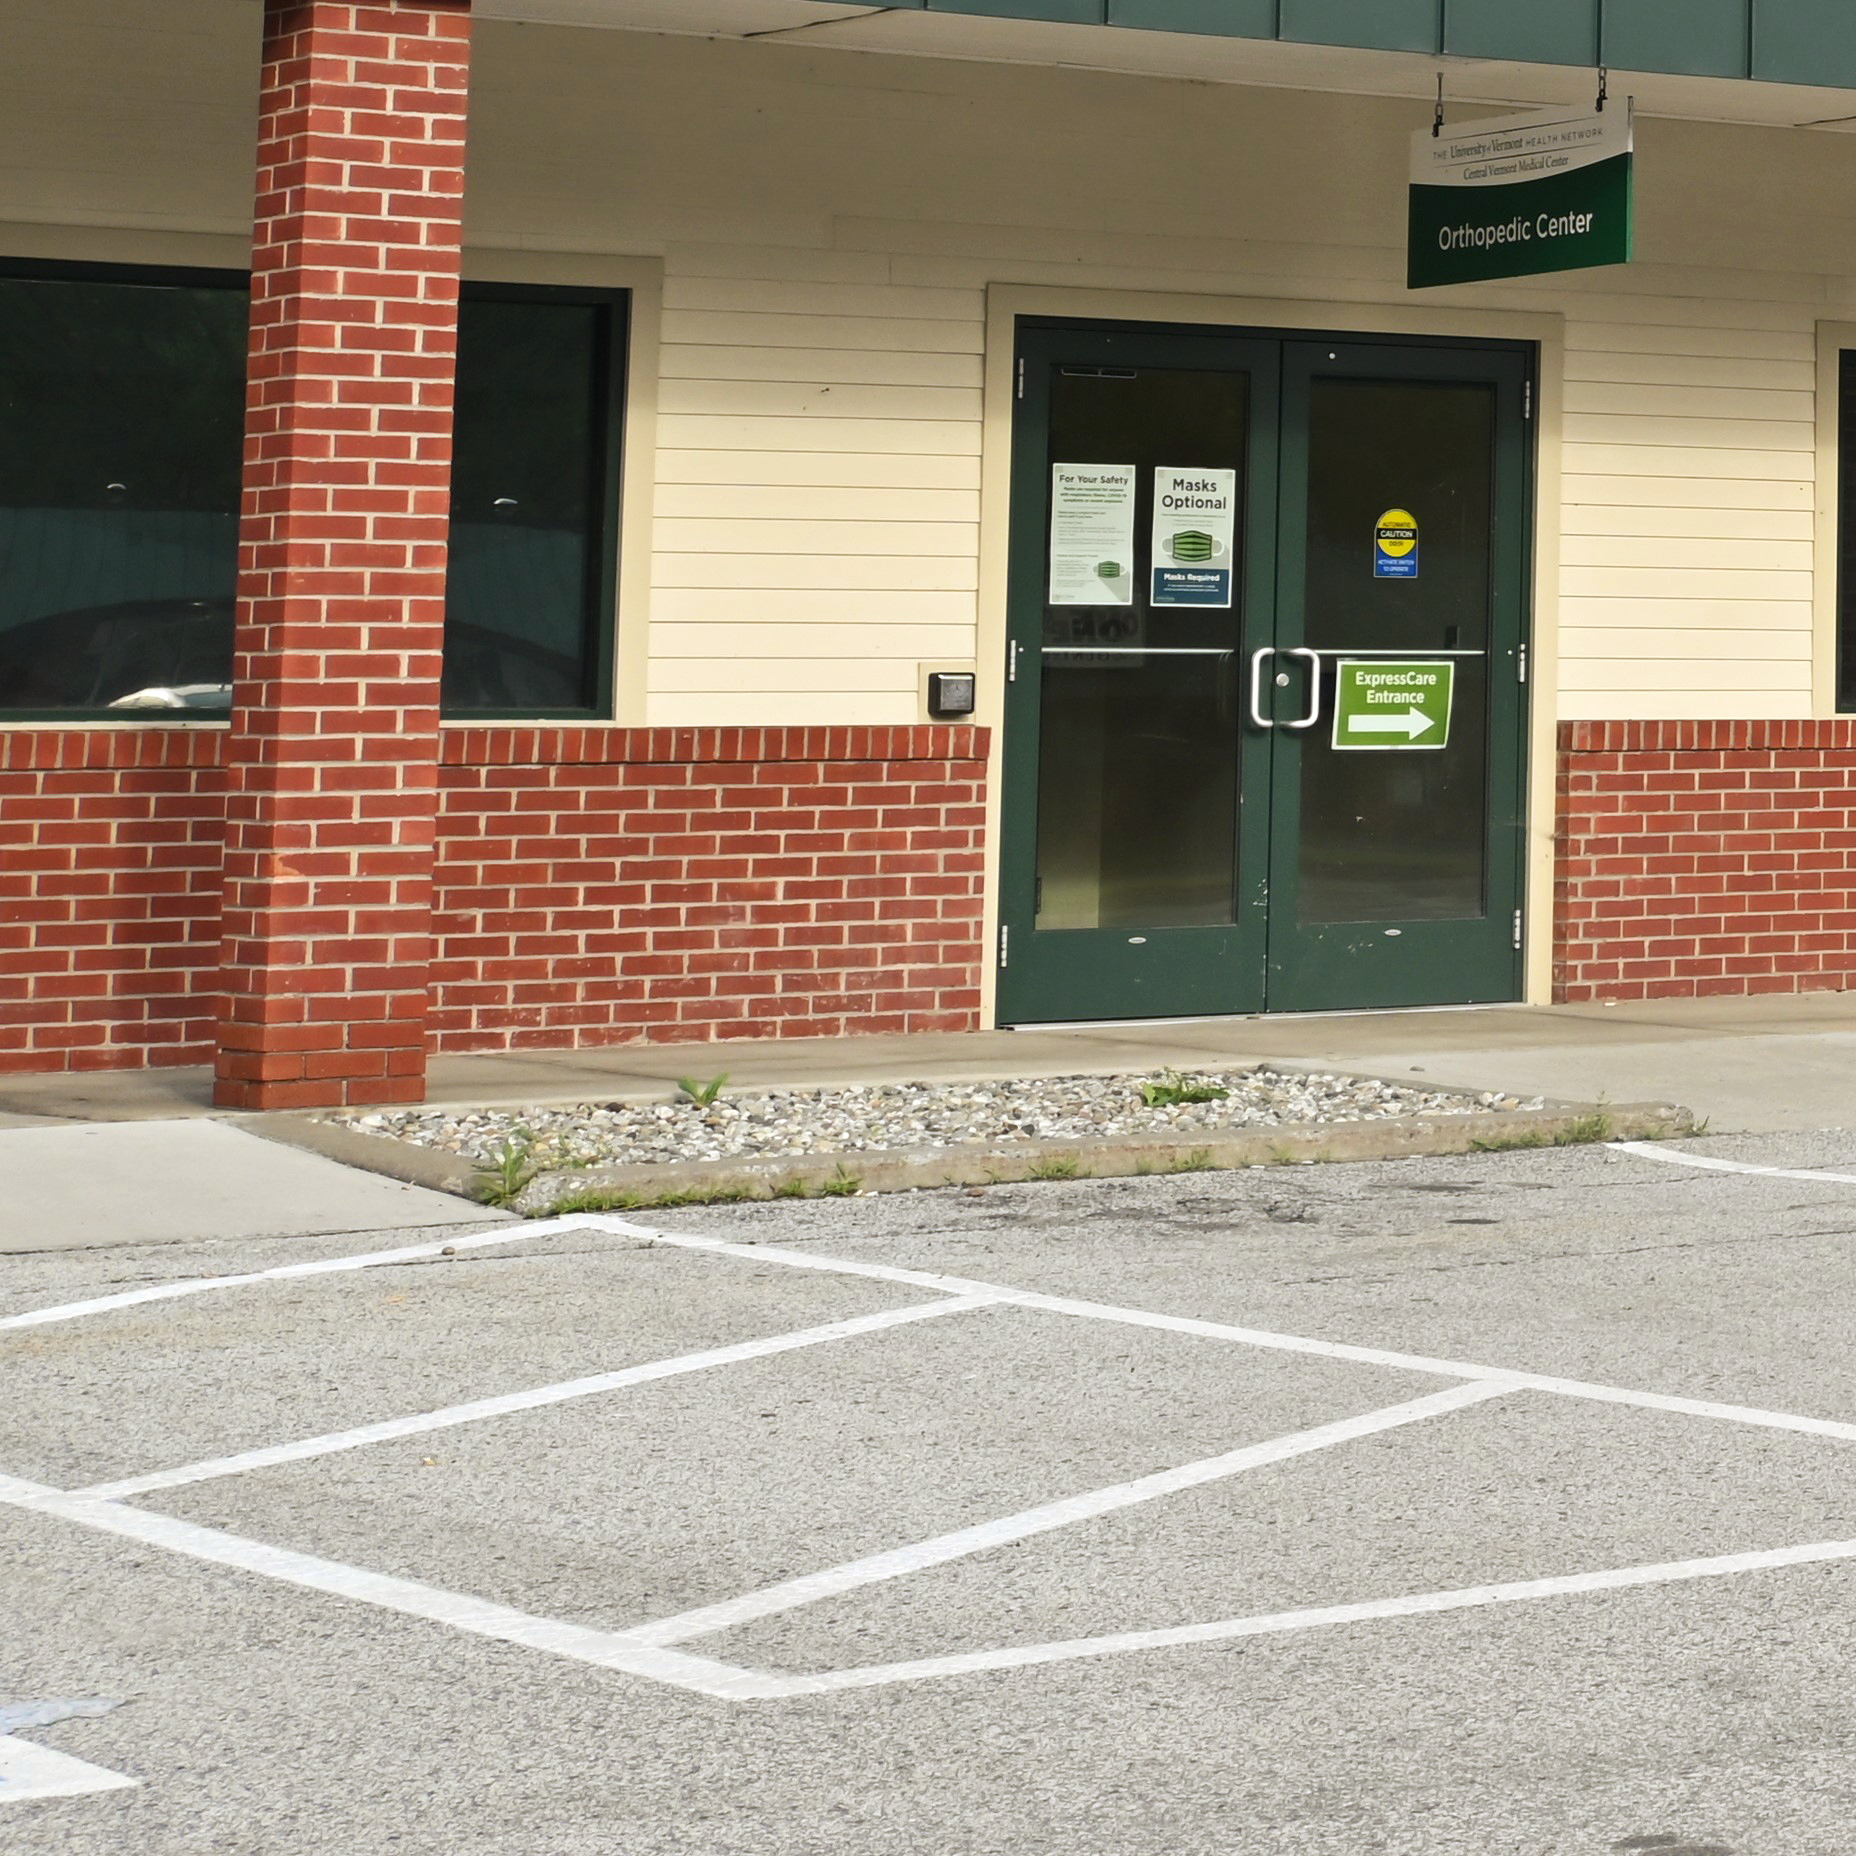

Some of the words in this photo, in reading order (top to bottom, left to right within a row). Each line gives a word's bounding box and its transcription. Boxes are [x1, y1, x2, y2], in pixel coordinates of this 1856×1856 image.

[1450, 142, 1487, 160] University
[1491, 137, 1523, 152] Vermont
[1525, 135, 1558, 147] HEALTH
[1561, 128, 1603, 142] NETWORK
[1463, 165, 1488, 181] Central
[1488, 161, 1517, 177] Vermont
[1518, 157, 1545, 172] Medical
[1546, 154, 1569, 168] Center
[1438, 215, 1531, 251] Orthopedic
[1536, 210, 1593, 239] Center
[1059, 474, 1074, 483] For
[1078, 475, 1098, 484] Your
[1100, 475, 1129, 486] Safety
[1172, 478, 1217, 492] Masks
[1161, 494, 1227, 511] Optional
[1380, 530, 1413, 538] CAUTION
[1163, 572, 1186, 581] Masks
[1187, 572, 1220, 583] Required
[1355, 671, 1437, 687] ExpressCare
[1366, 689, 1425, 704] Entrance
